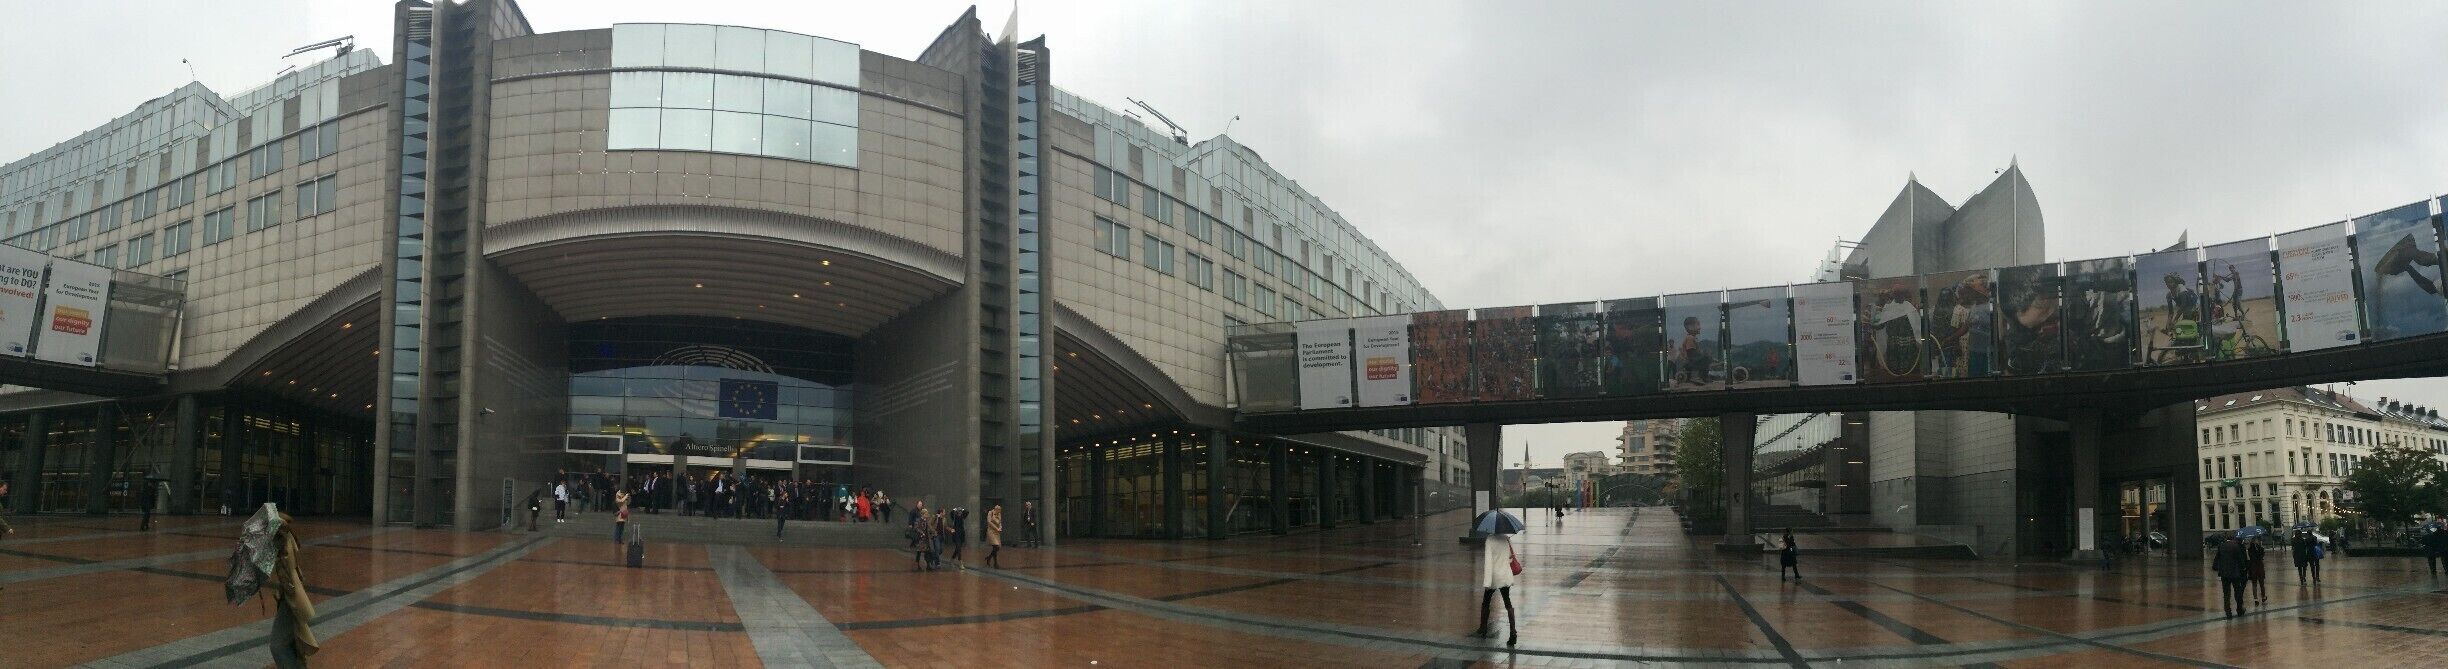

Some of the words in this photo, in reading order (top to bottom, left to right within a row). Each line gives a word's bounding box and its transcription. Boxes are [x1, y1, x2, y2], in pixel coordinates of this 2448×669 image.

[7, 267, 20, 275] are
[22, 268, 38, 279] YOU
[11, 277, 19, 286] to
[21, 278, 37, 289] DO?
[63, 283, 87, 292] European
[64, 290, 97, 301] Development
[67, 318, 90, 328] dignity
[66, 325, 86, 334] future
[1308, 354, 1339, 362] committed
[1303, 361, 1343, 369] development.
[685, 443, 709, 451] Altiero
[709, 444, 734, 453] Spinelli
